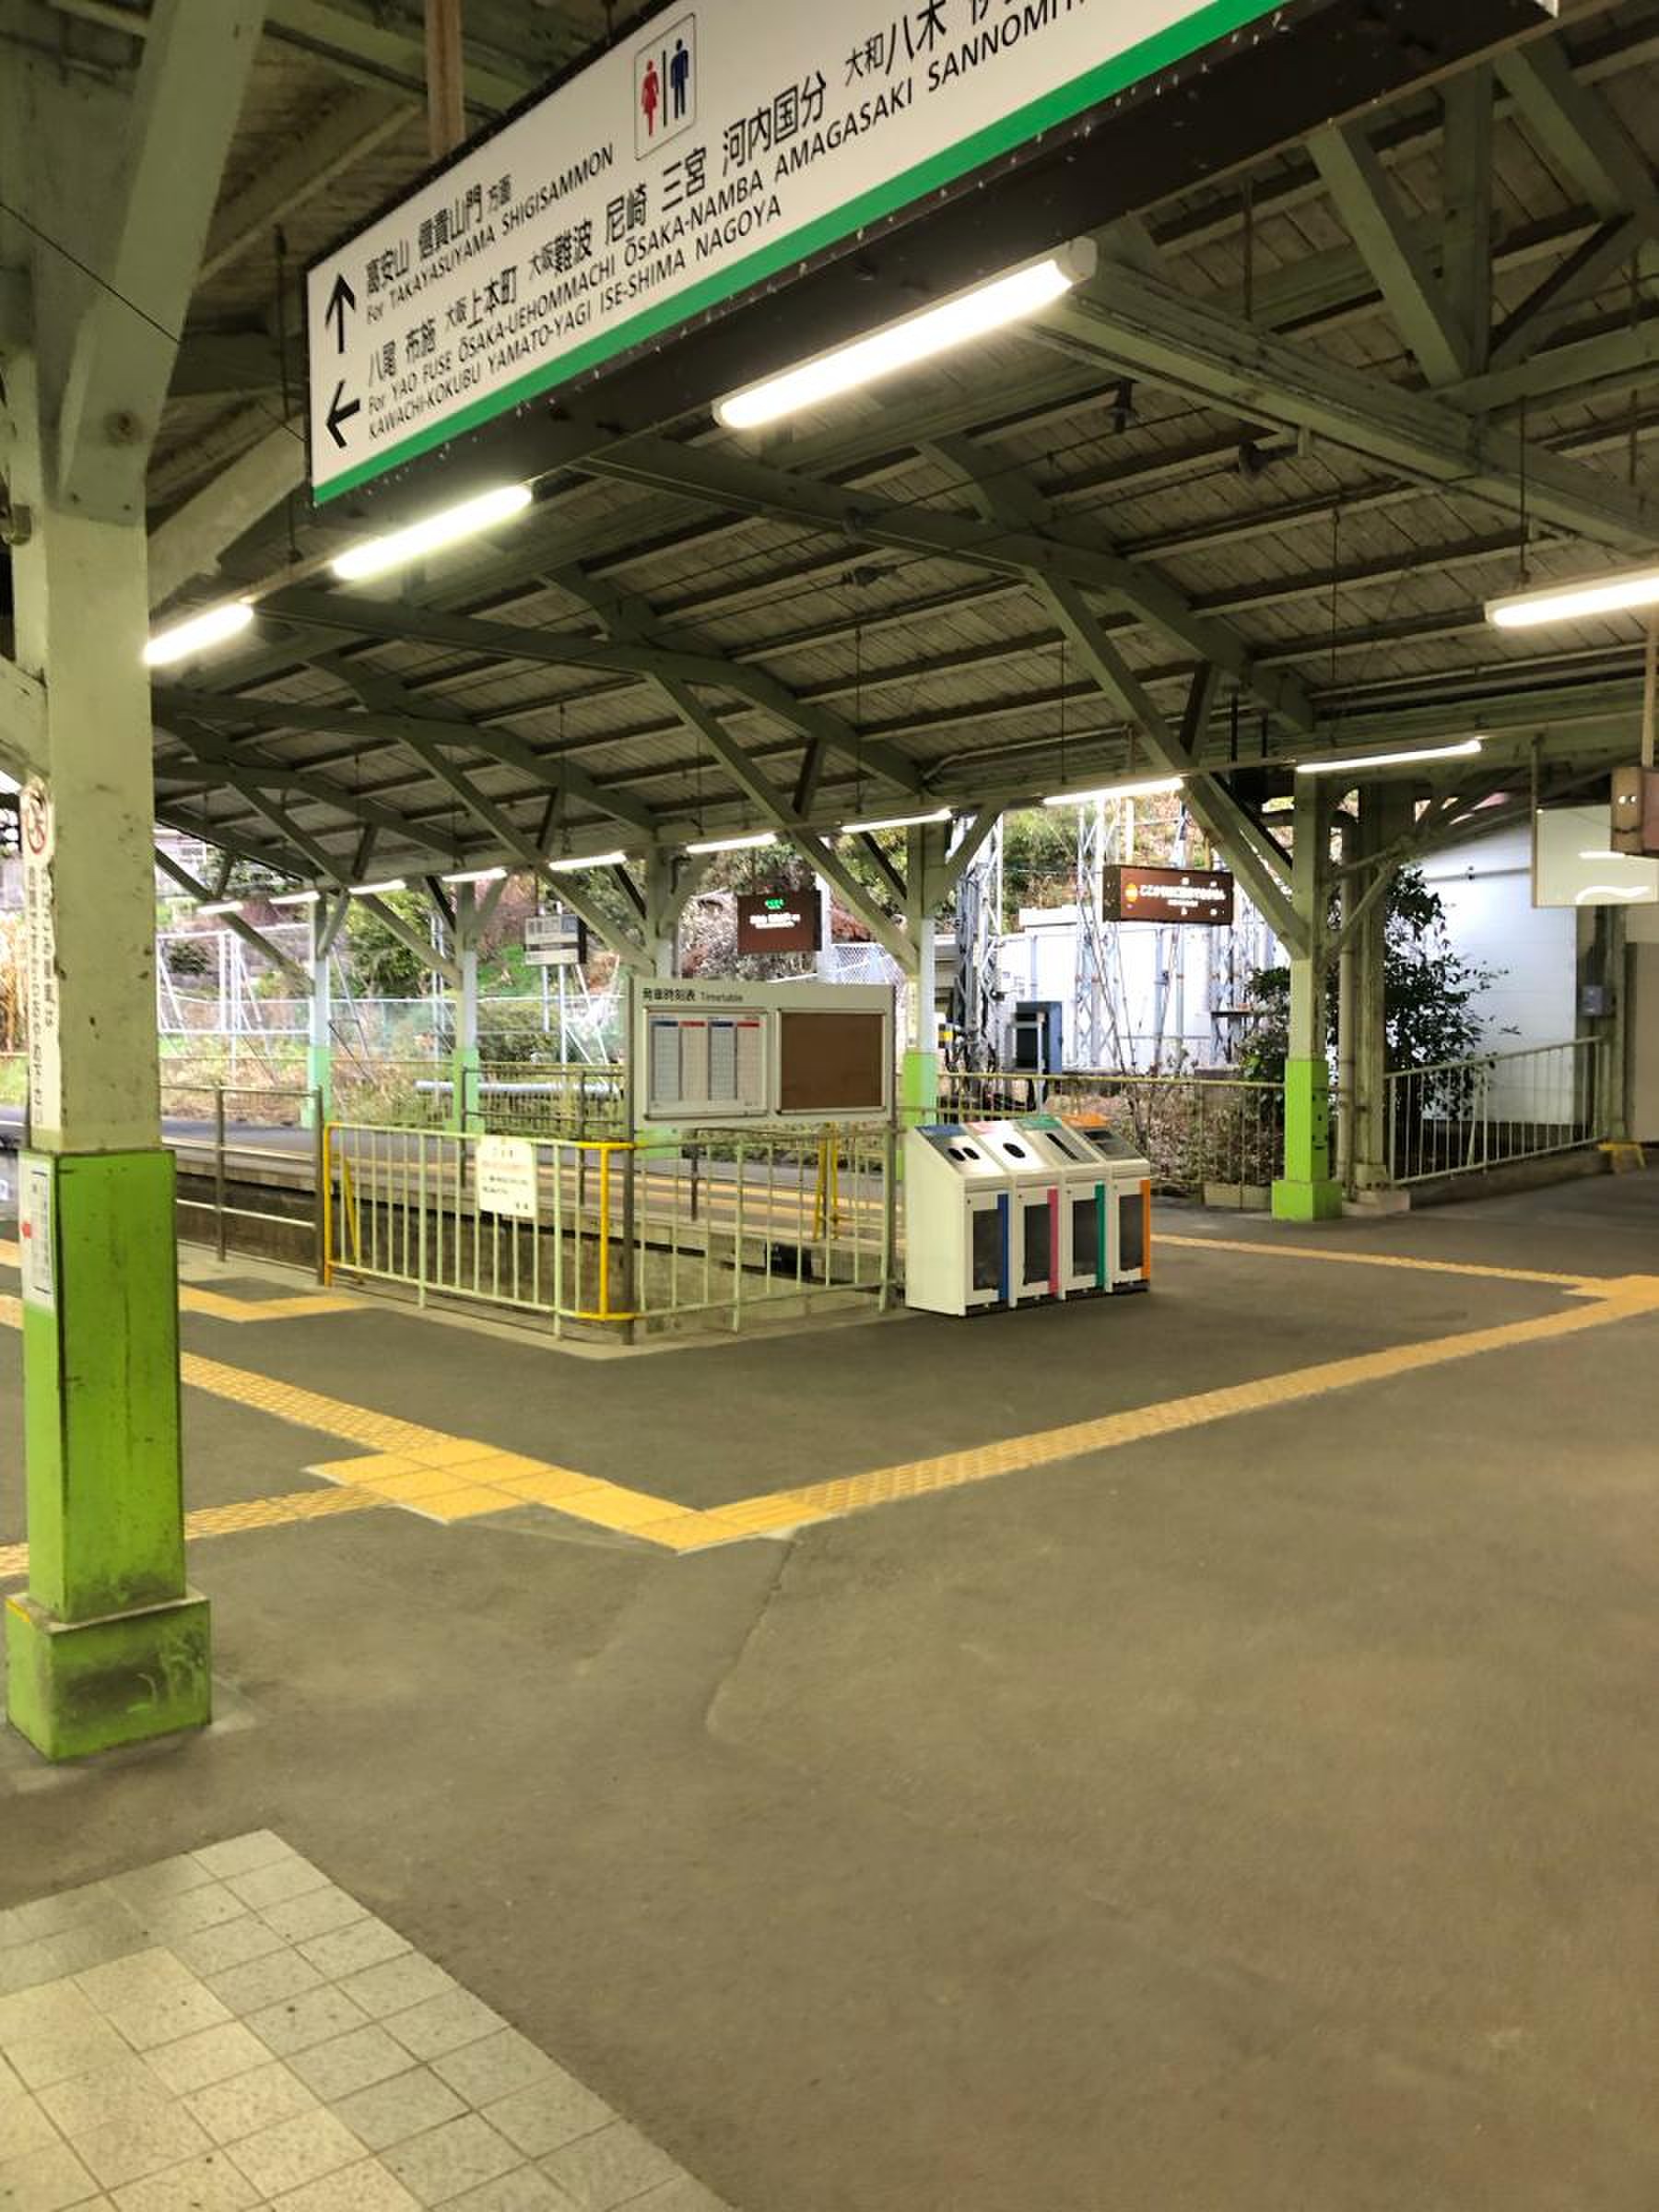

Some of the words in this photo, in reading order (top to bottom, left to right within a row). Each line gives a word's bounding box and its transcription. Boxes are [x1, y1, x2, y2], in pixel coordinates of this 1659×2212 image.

[367, 302, 383, 324] For
[389, 224, 496, 311] TAKAYASUYAMA
[501, 141, 614, 237] SHIGISAMMON
[368, 339, 396, 388] 八尾
[406, 318, 436, 364] 布施
[445, 265, 518, 333] 大阪上本町
[528, 218, 593, 281] 大阪難波
[605, 182, 647, 246] 尼崎
[662, 146, 707, 213] 三宮
[723, 69, 827, 178] 河内国分
[844, 0, 947, 87] 大和八木
[368, 394, 384, 416] For
[391, 372, 418, 401] YAO
[423, 350, 453, 384] FUSE
[624, 170, 764, 266] ŌSAKA-NAMBA
[774, 76, 912, 183] AMAGASAKI
[927, 0, 1086, 92] SANNOMI
[369, 361, 481, 441] KAWACHI-KOKUBU
[488, 300, 592, 375] YAMATO-YAGI
[600, 248, 687, 313] ISE-SHIMA
[695, 194, 782, 262] NAGOYA
